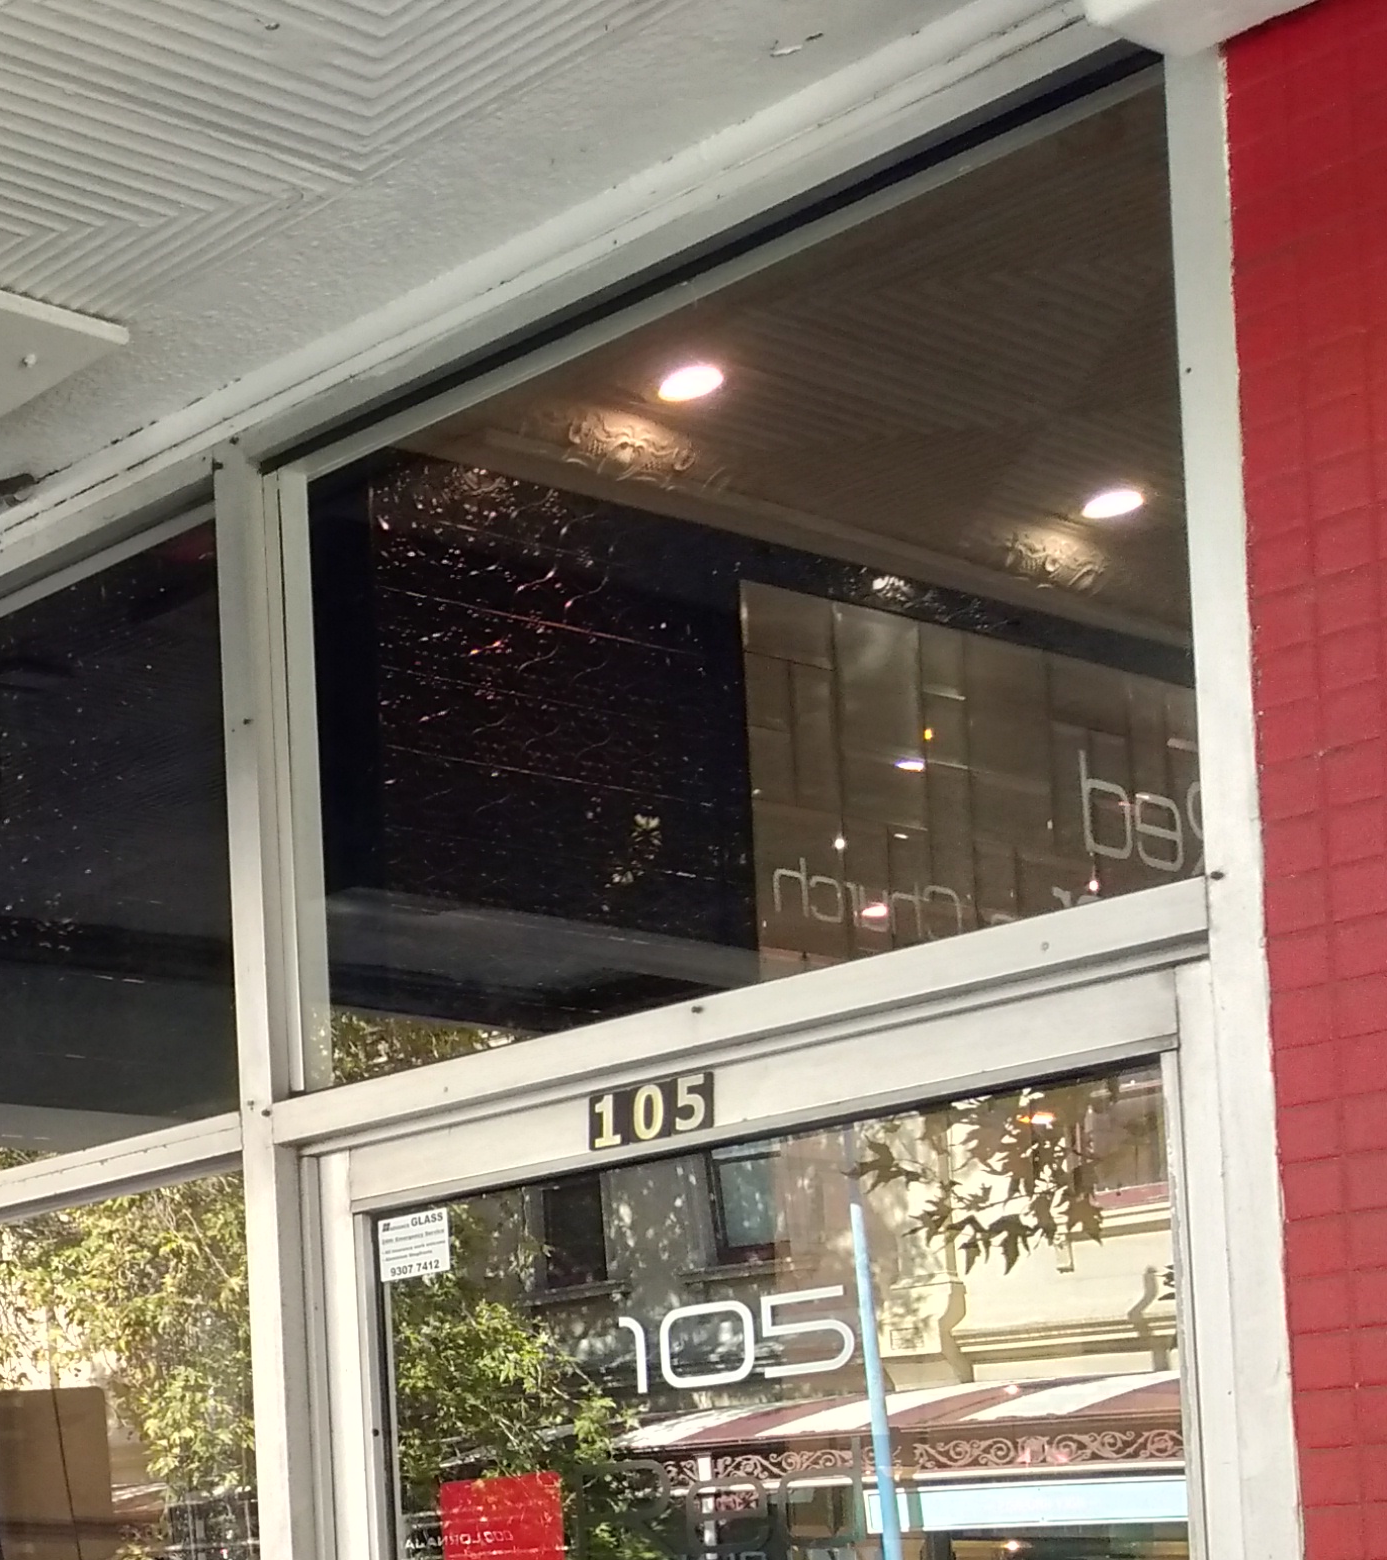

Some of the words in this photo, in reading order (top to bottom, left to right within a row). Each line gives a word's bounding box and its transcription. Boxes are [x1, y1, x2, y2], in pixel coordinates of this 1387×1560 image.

[592, 1074, 707, 1148] 105
[411, 1212, 444, 1227] GLASS
[390, 1263, 414, 1278] 9307
[416, 1258, 440, 1273] 7412
[618, 1285, 855, 1394] 105
